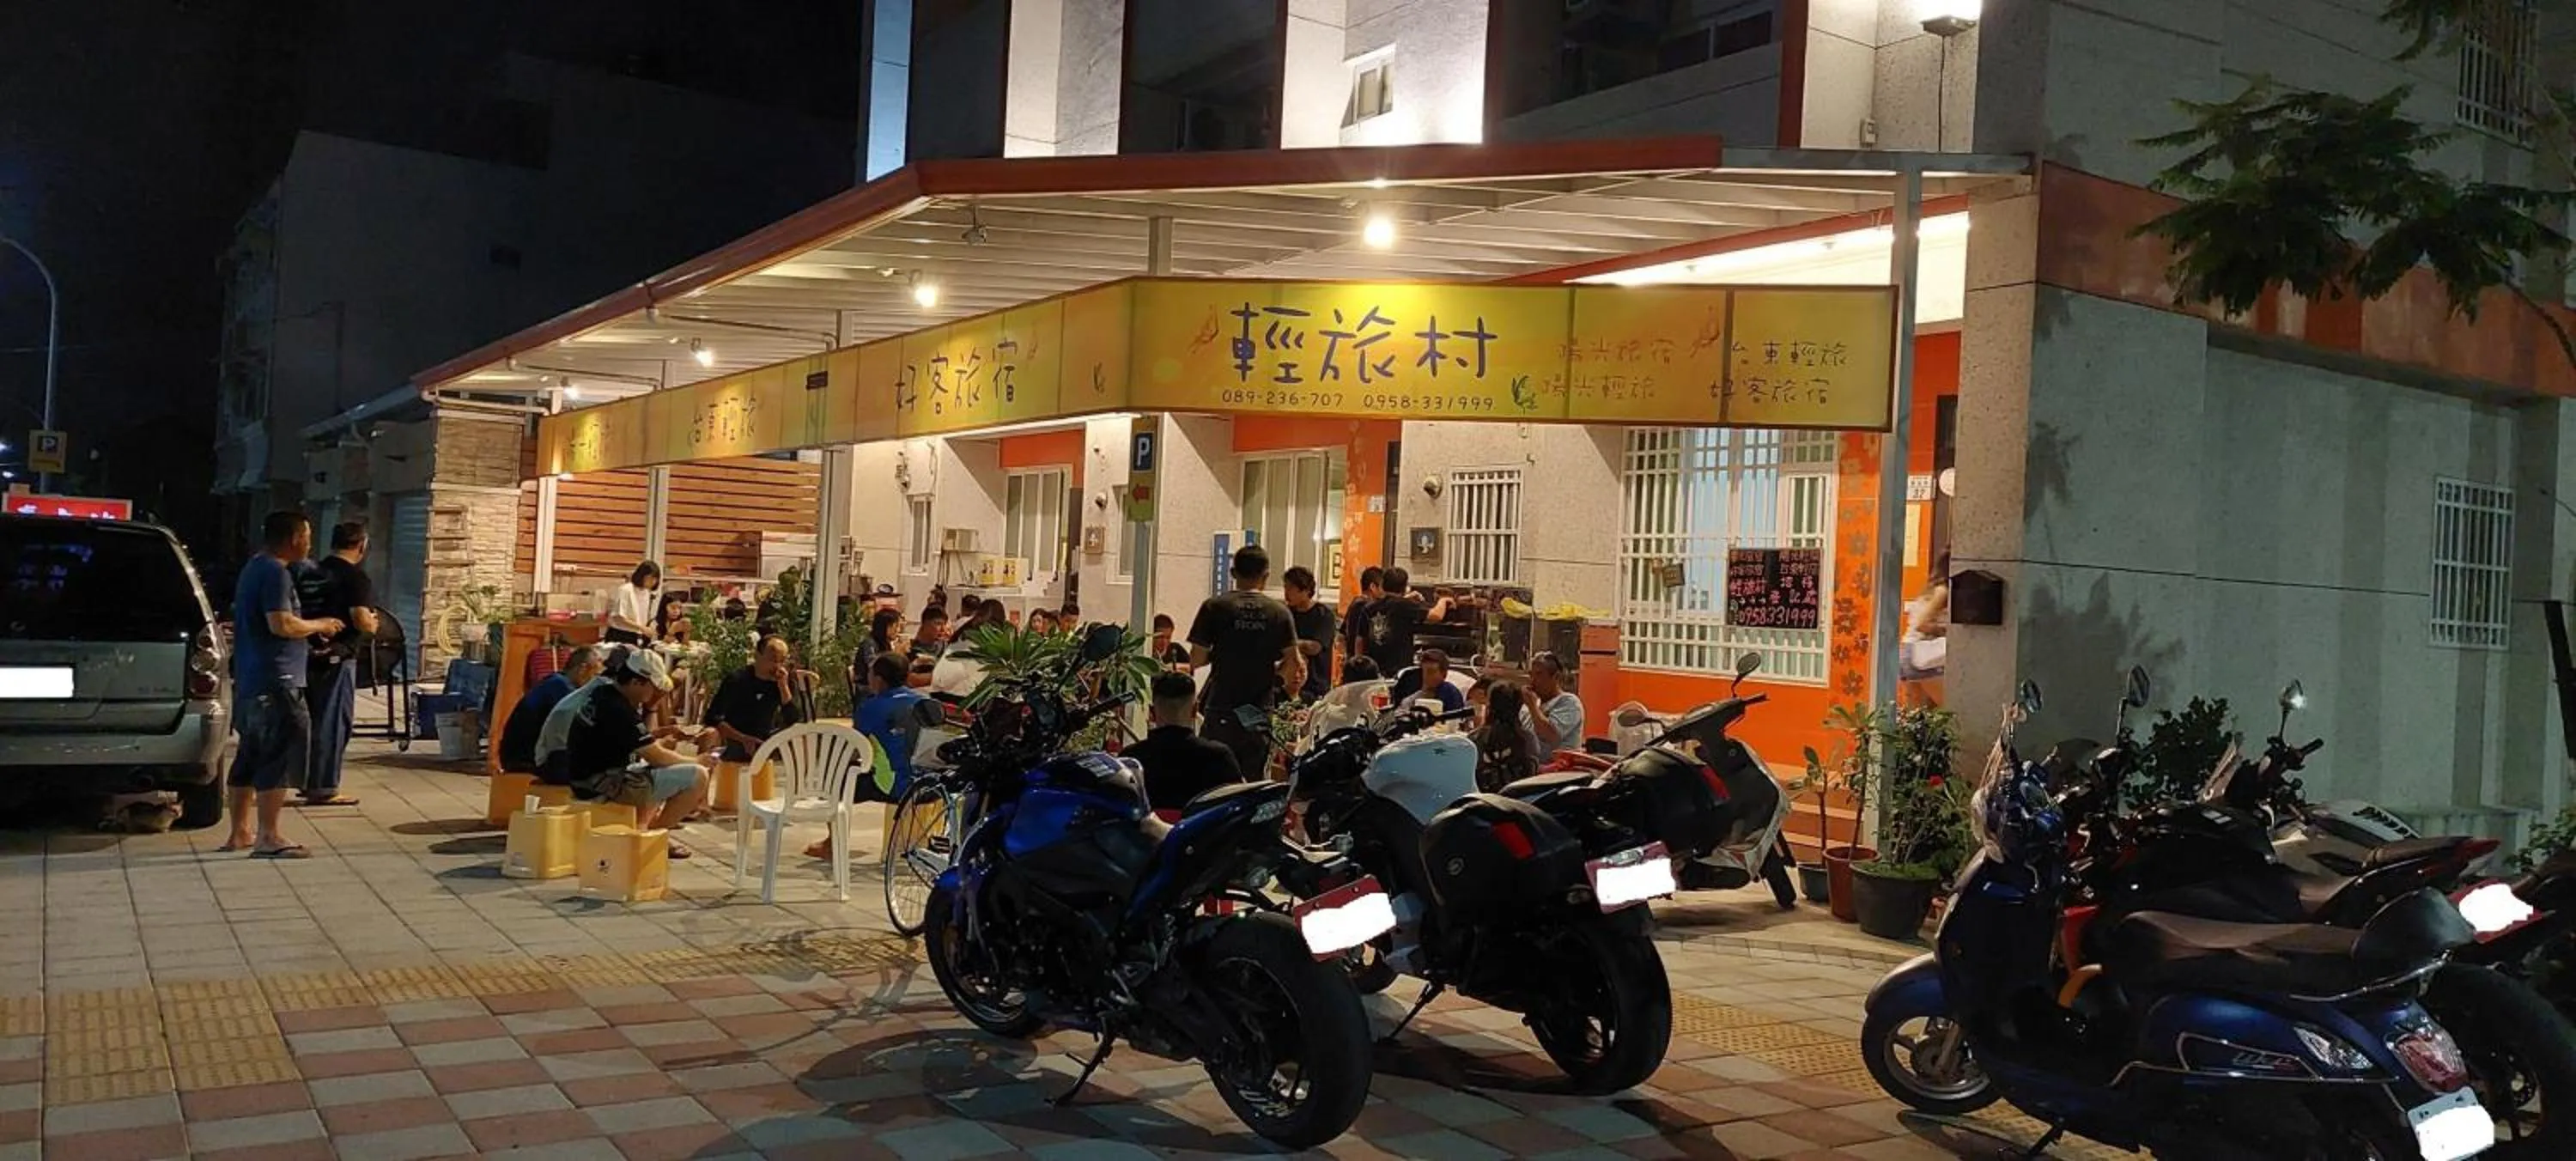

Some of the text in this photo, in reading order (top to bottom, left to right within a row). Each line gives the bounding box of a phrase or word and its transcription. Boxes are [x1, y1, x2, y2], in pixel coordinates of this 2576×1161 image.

[1230, 301, 1499, 384] 輕旅村
[1730, 340, 1847, 368] 台東輕旅
[895, 337, 1018, 415] 好客旅宿
[1222, 390, 1495, 412] 089-236-707 0958-331999
[1136, 436, 1151, 467] P
